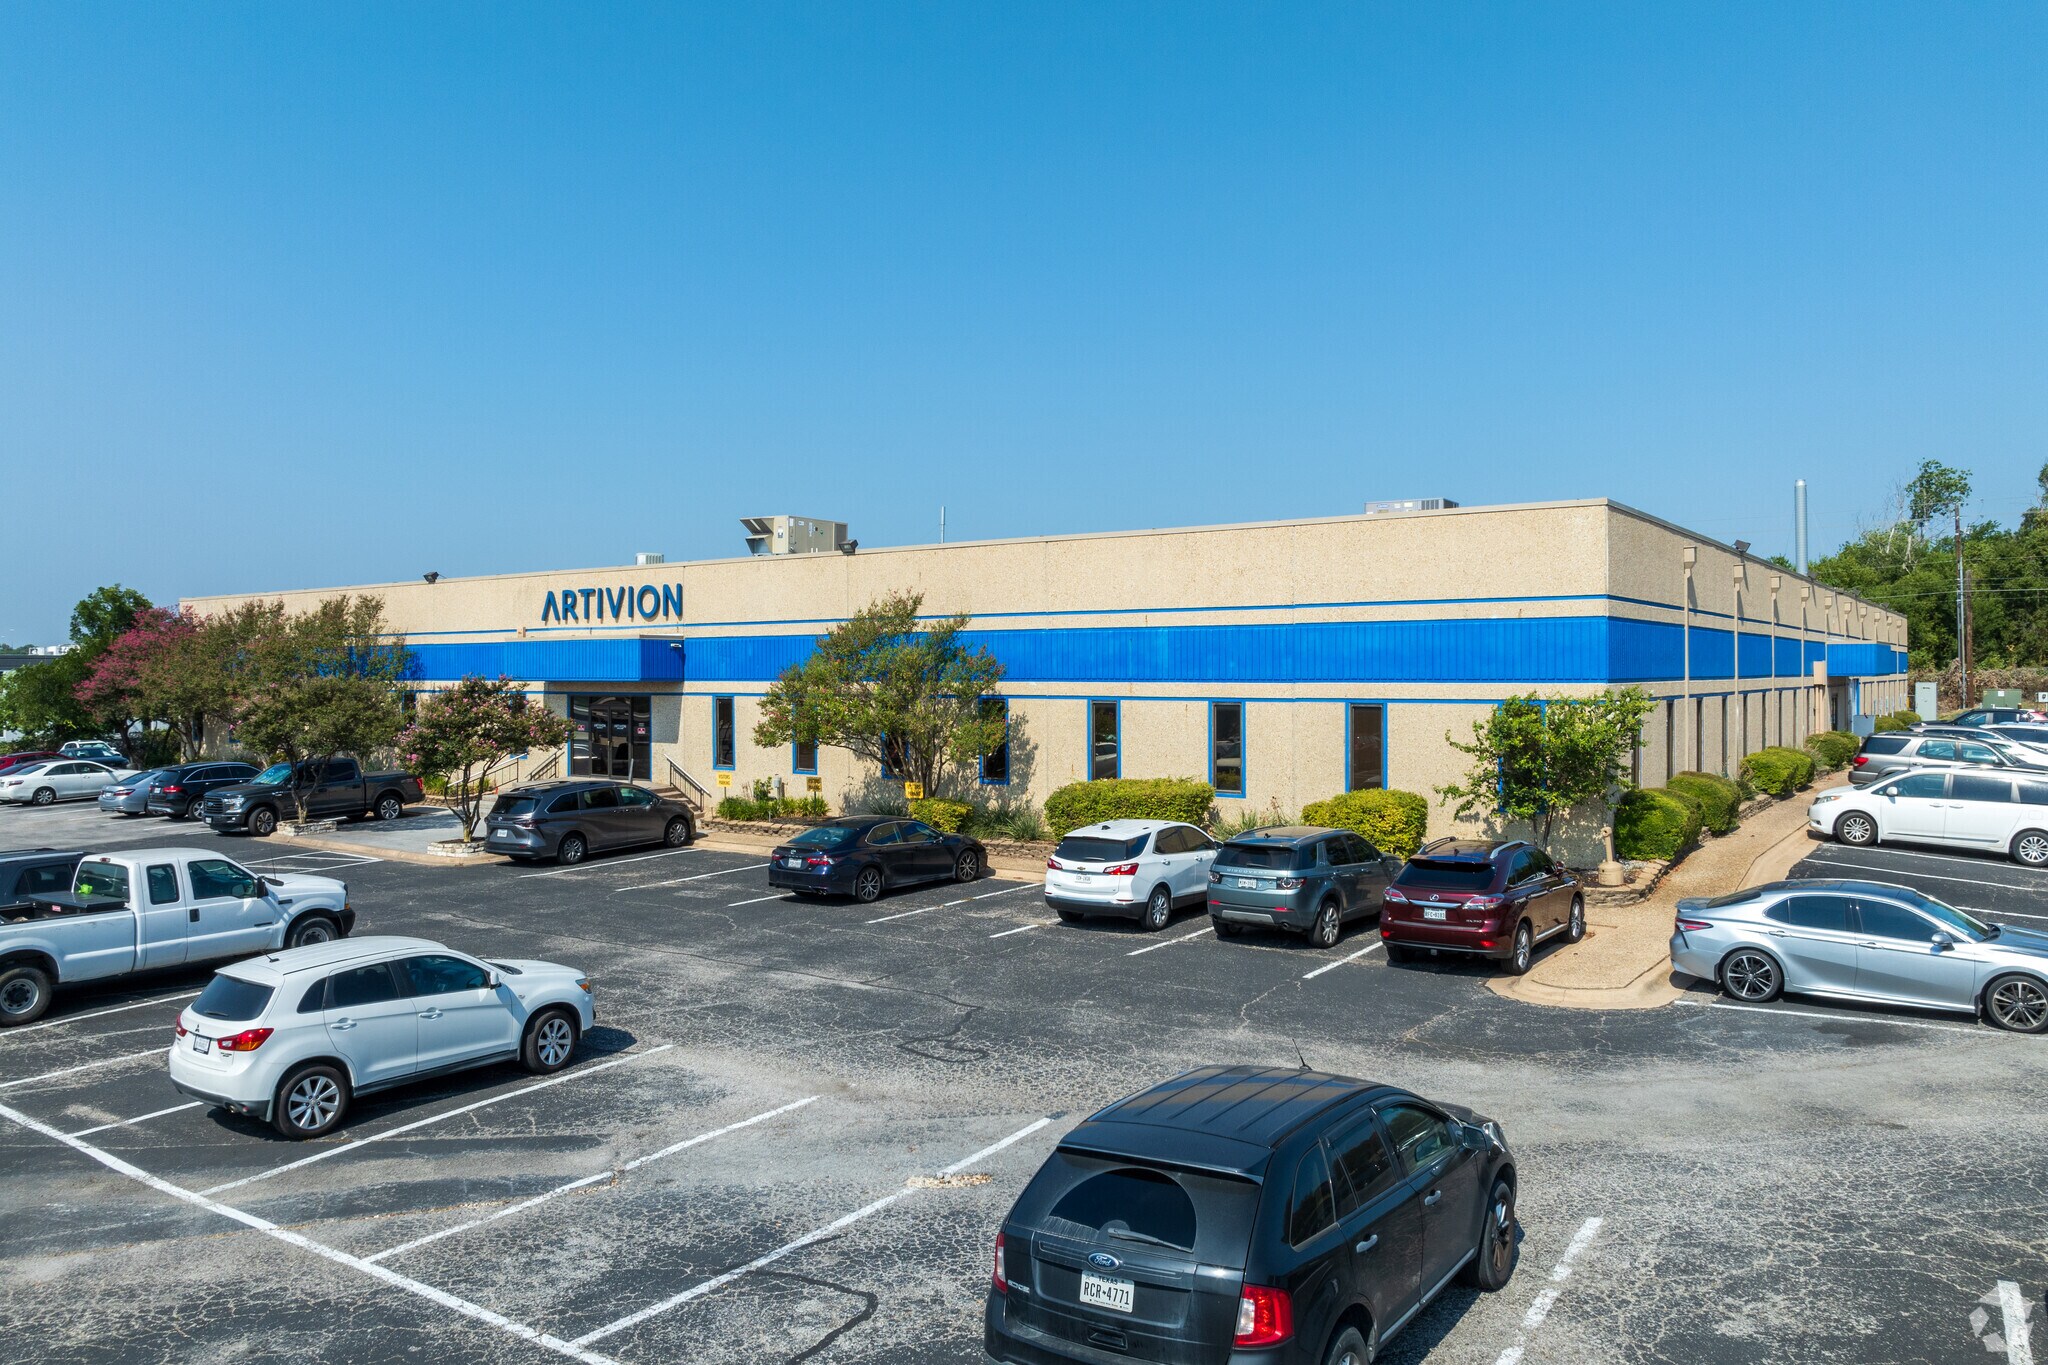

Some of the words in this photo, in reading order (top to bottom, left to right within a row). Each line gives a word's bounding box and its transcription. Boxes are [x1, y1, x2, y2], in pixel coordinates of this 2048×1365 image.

[541, 583, 683, 622] ARTIVION
[1094, 1255, 1112, 1267] Ford
[1098, 1275, 1118, 1286] TEXAS
